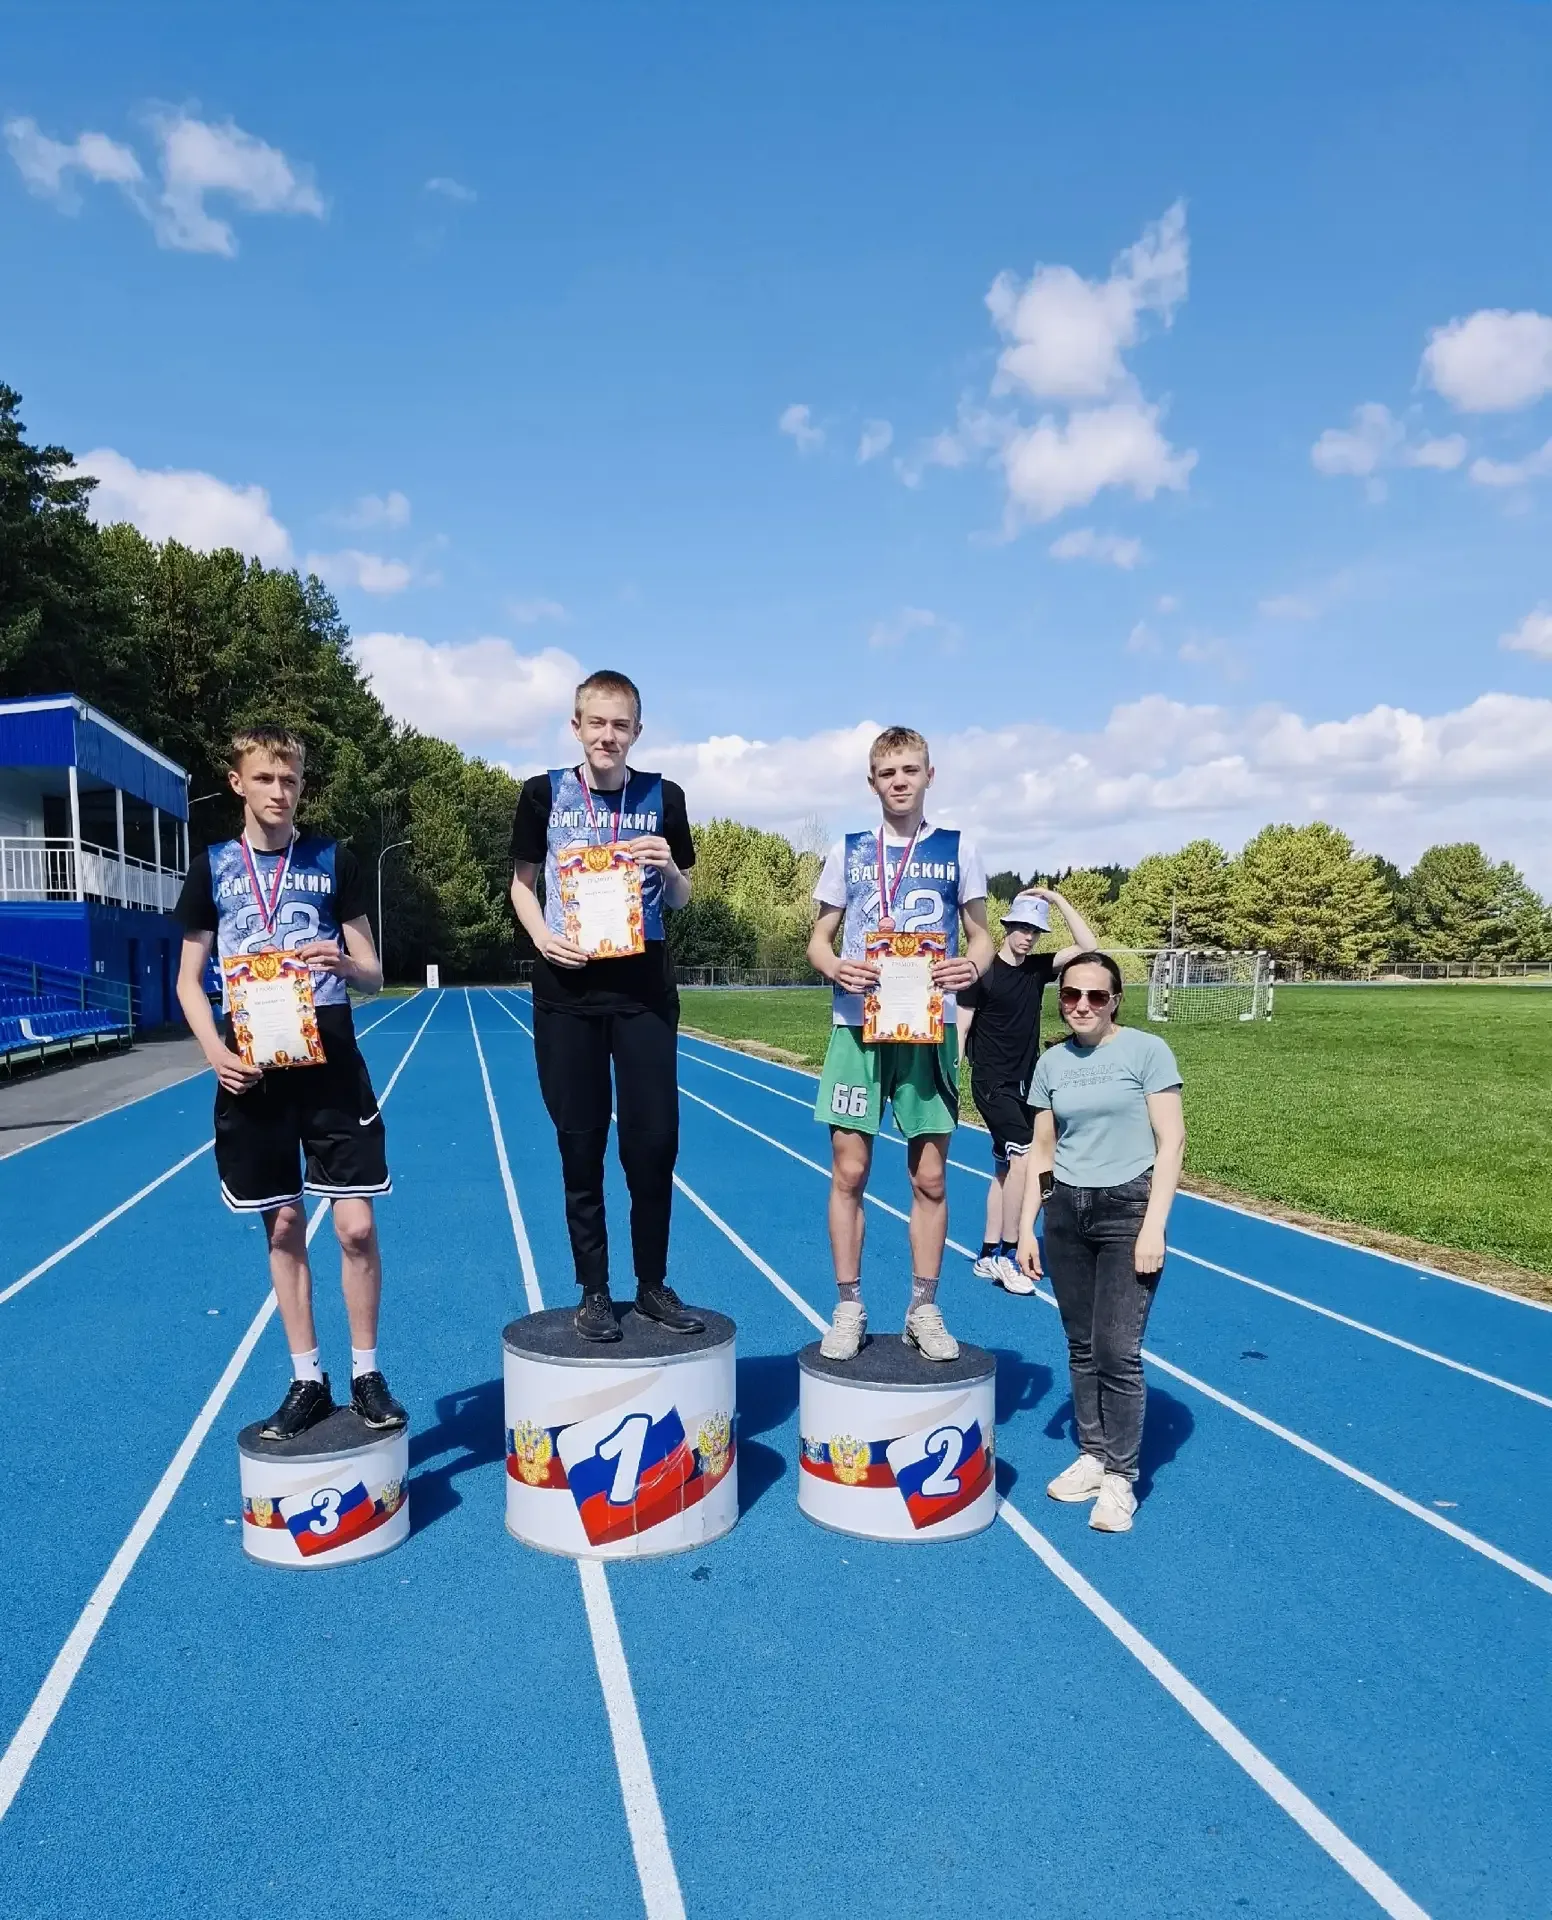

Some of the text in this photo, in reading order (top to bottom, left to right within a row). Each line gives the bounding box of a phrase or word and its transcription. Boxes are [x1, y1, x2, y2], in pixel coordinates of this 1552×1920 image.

[831, 1083, 867, 1117] 66
[594, 1413, 653, 1506] 1
[925, 1426, 963, 1497] 2
[309, 1488, 342, 1535] 3
